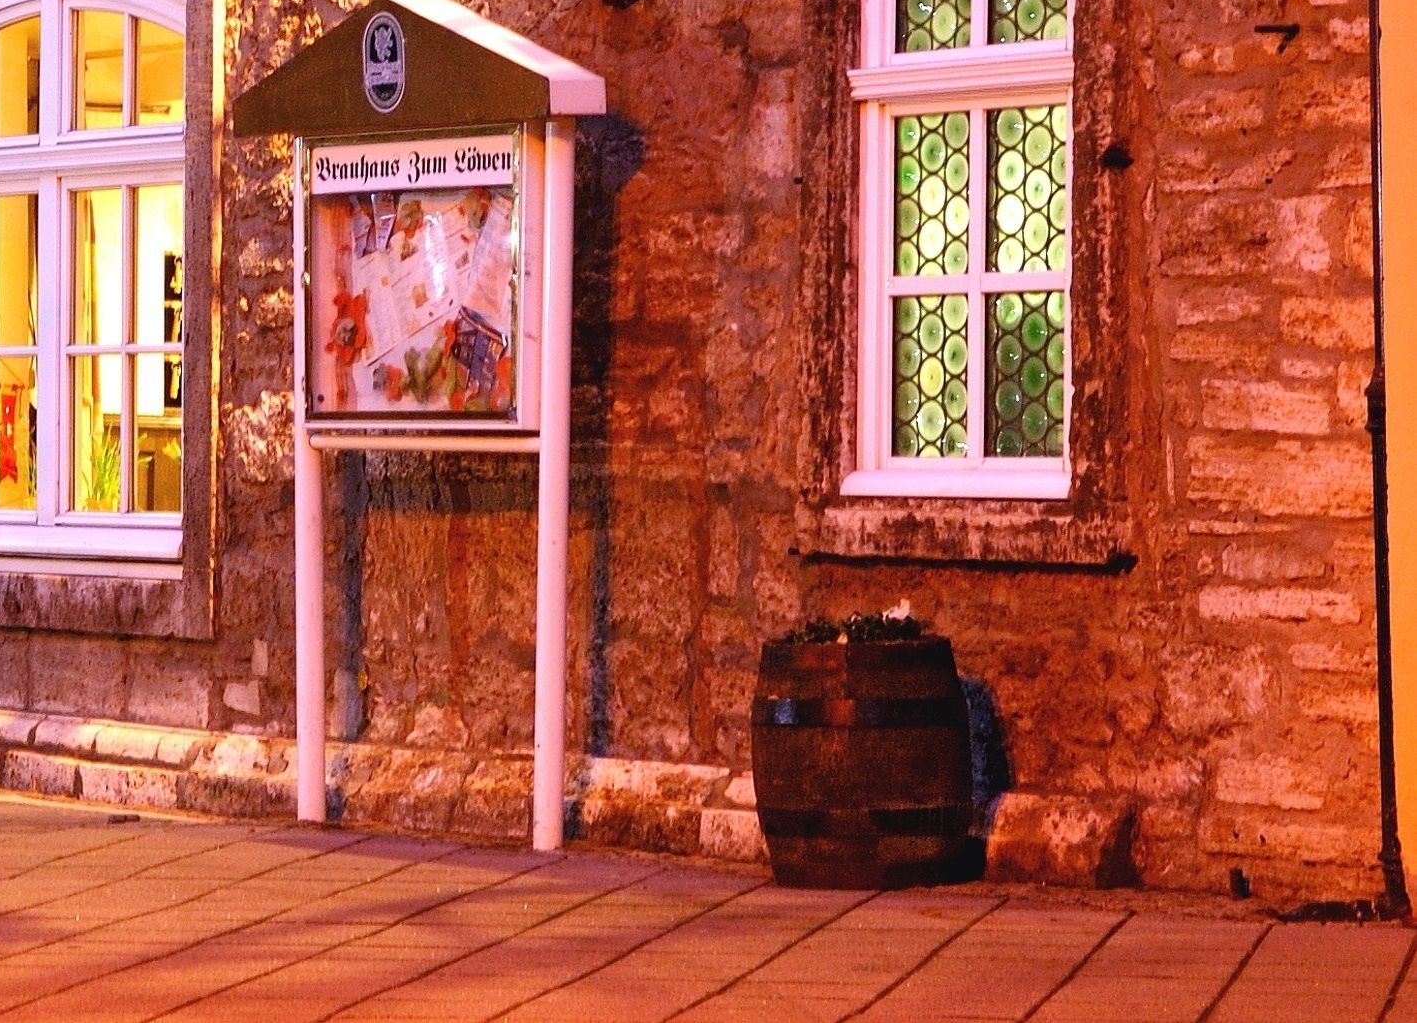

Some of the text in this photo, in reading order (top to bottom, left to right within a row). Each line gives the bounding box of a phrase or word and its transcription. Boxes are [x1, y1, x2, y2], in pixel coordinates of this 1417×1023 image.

[316, 147, 511, 185] Brauhaus Zum Löwen
